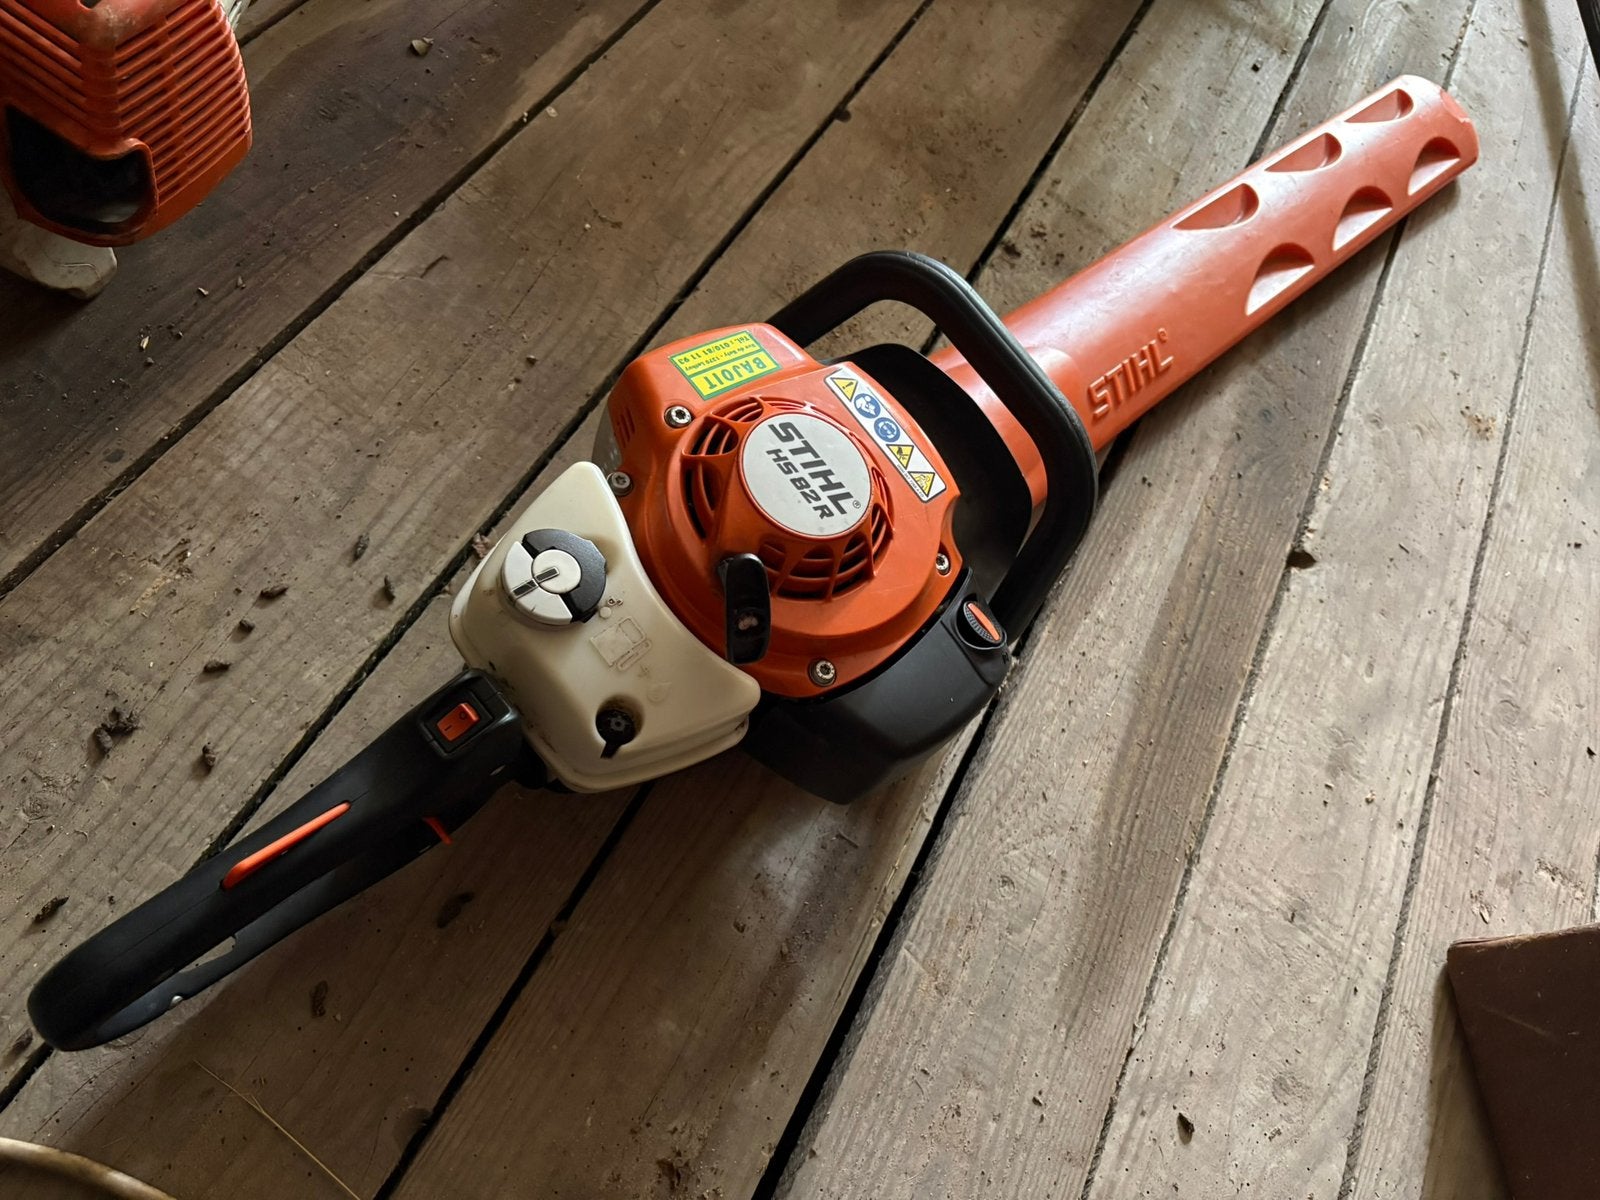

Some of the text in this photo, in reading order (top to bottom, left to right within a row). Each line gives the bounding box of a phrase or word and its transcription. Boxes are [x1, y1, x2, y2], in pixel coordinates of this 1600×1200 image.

[677, 357, 690, 365] 93
[690, 352, 702, 360] 11
[702, 342, 730, 356] 010/81
[704, 357, 767, 390] BAJOIT
[1087, 340, 1174, 424] STIHL
[765, 448, 835, 520] HS 82 R
[767, 421, 854, 515] STIHL
